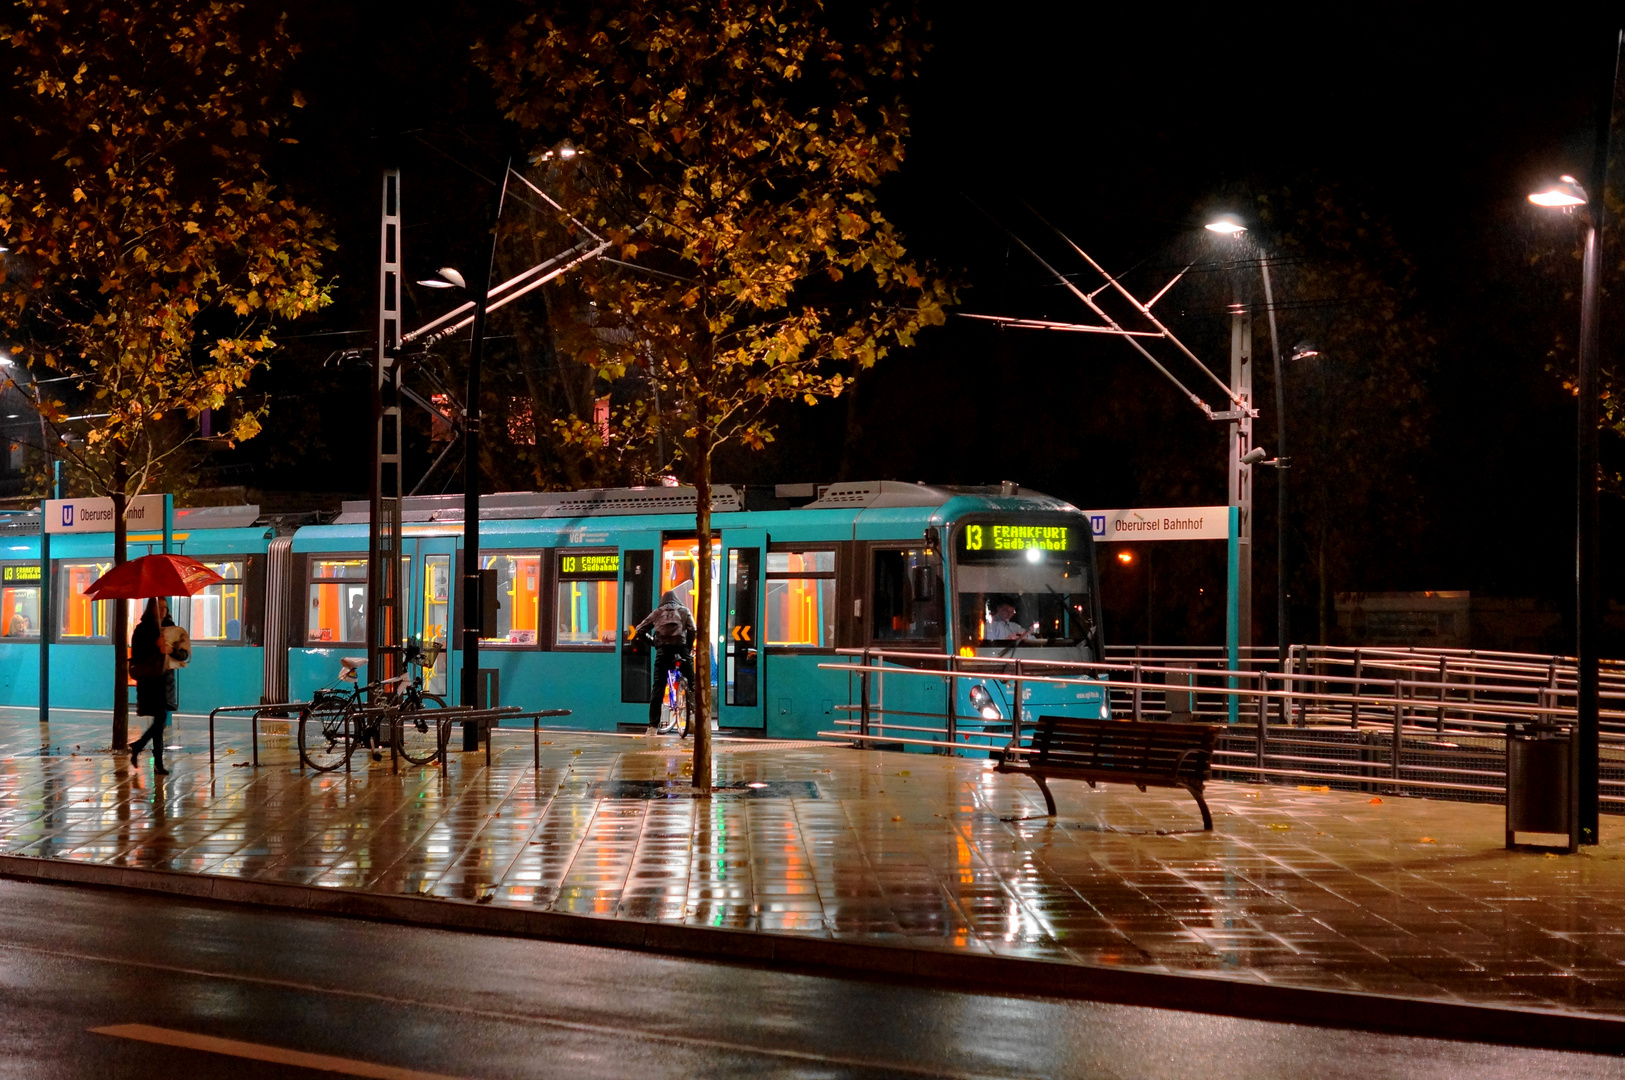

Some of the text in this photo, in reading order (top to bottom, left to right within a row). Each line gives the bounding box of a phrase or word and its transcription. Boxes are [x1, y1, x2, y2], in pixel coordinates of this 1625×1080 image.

[80, 508, 113, 521] Oberursel
[1115, 519, 1160, 531] Oberursel
[1163, 518, 1203, 530] Bahnhof
[994, 526, 1067, 538] FRANKFURT
[995, 538, 1067, 550] Südbahnhof
[563, 557, 576, 572] U3
[5, 567, 13, 580] U3
